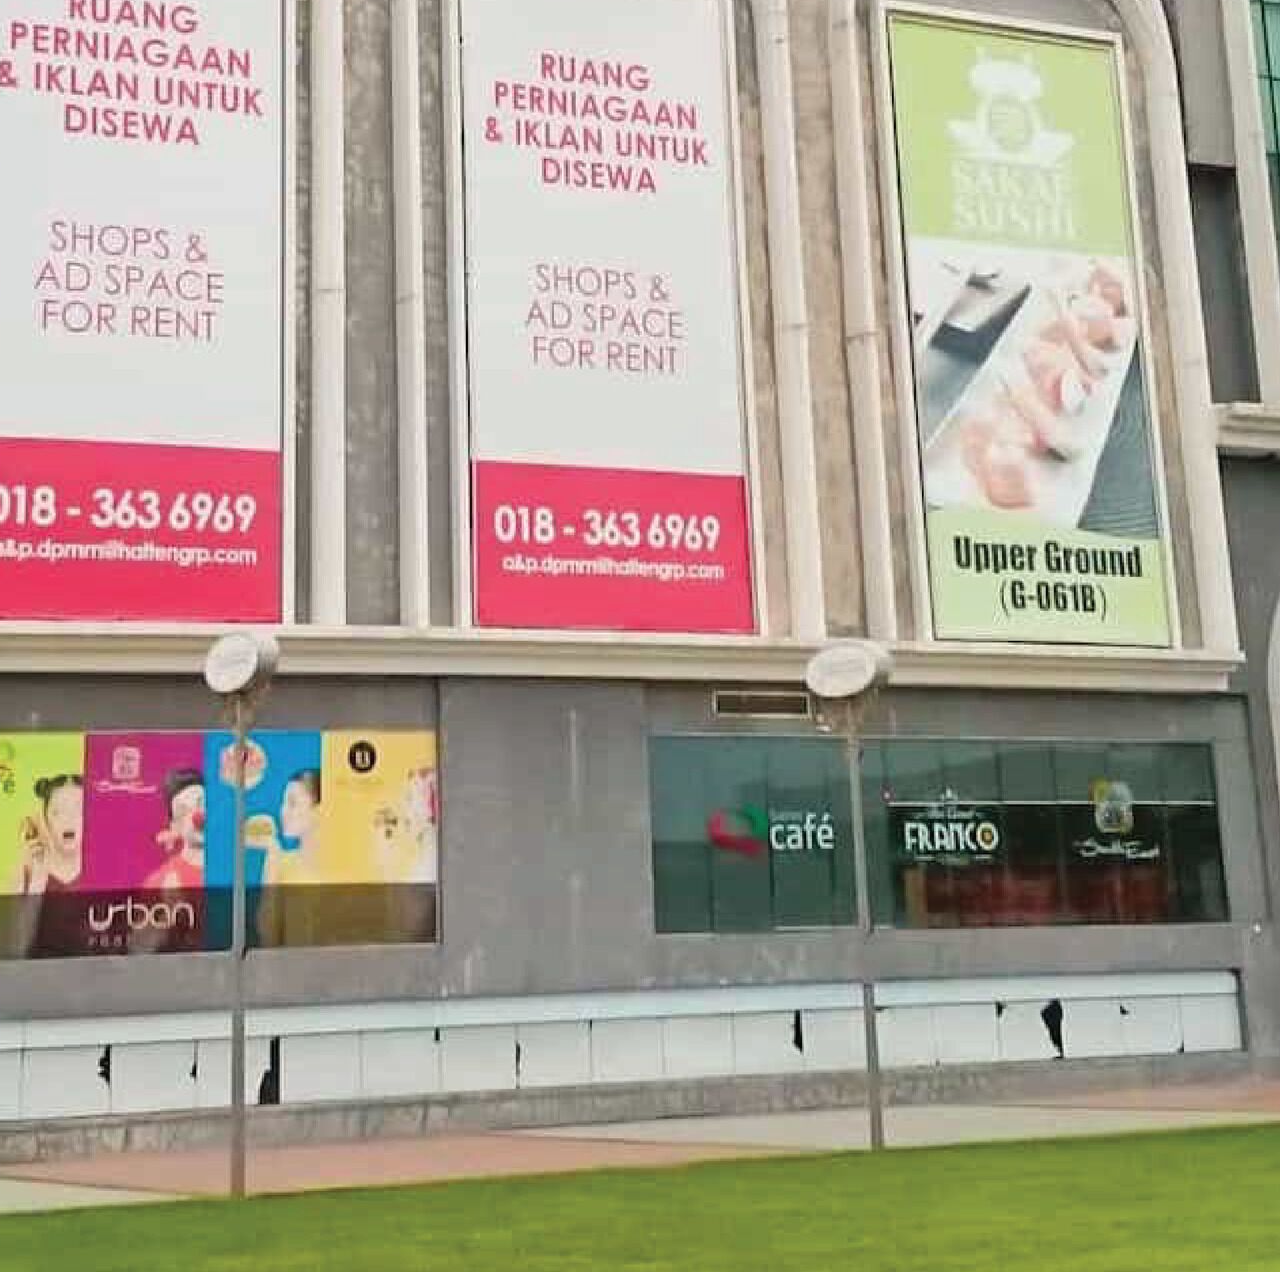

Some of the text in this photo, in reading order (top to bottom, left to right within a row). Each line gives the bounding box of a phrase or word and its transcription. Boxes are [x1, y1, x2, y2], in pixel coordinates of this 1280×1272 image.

[9, 22, 252, 78] PERNIAGAAN
[34, 62, 139, 101] IKLAN
[153, 77, 263, 116] UNTUK
[540, 53, 650, 92] RUANG
[64, 104, 200, 146] DISEWA
[494, 81, 697, 130] PERNIAGAAN
[484, 116, 708, 165] & IKLAN UNTUK
[541, 158, 657, 194] DISEWA
[50, 220, 208, 263] SHOPS &
[33, 260, 224, 304] AD SPACE
[535, 263, 670, 302] SHOPS &
[42, 299, 217, 343] FOR RENT
[525, 301, 686, 339] AD SPACE
[532, 336, 679, 375] FOR RENT
[91, 488, 161, 529] 363
[169, 491, 257, 533] 6969
[494, 504, 555, 544] 018
[583, 509, 641, 548] 363
[648, 513, 721, 552] 6969
[953, 535, 1143, 578] Upper Ground
[1000, 580, 1107, 621] (G-061B)
[771, 812, 835, 850] café
[904, 821, 999, 851] FRANCO
[89, 896, 196, 932] urban
